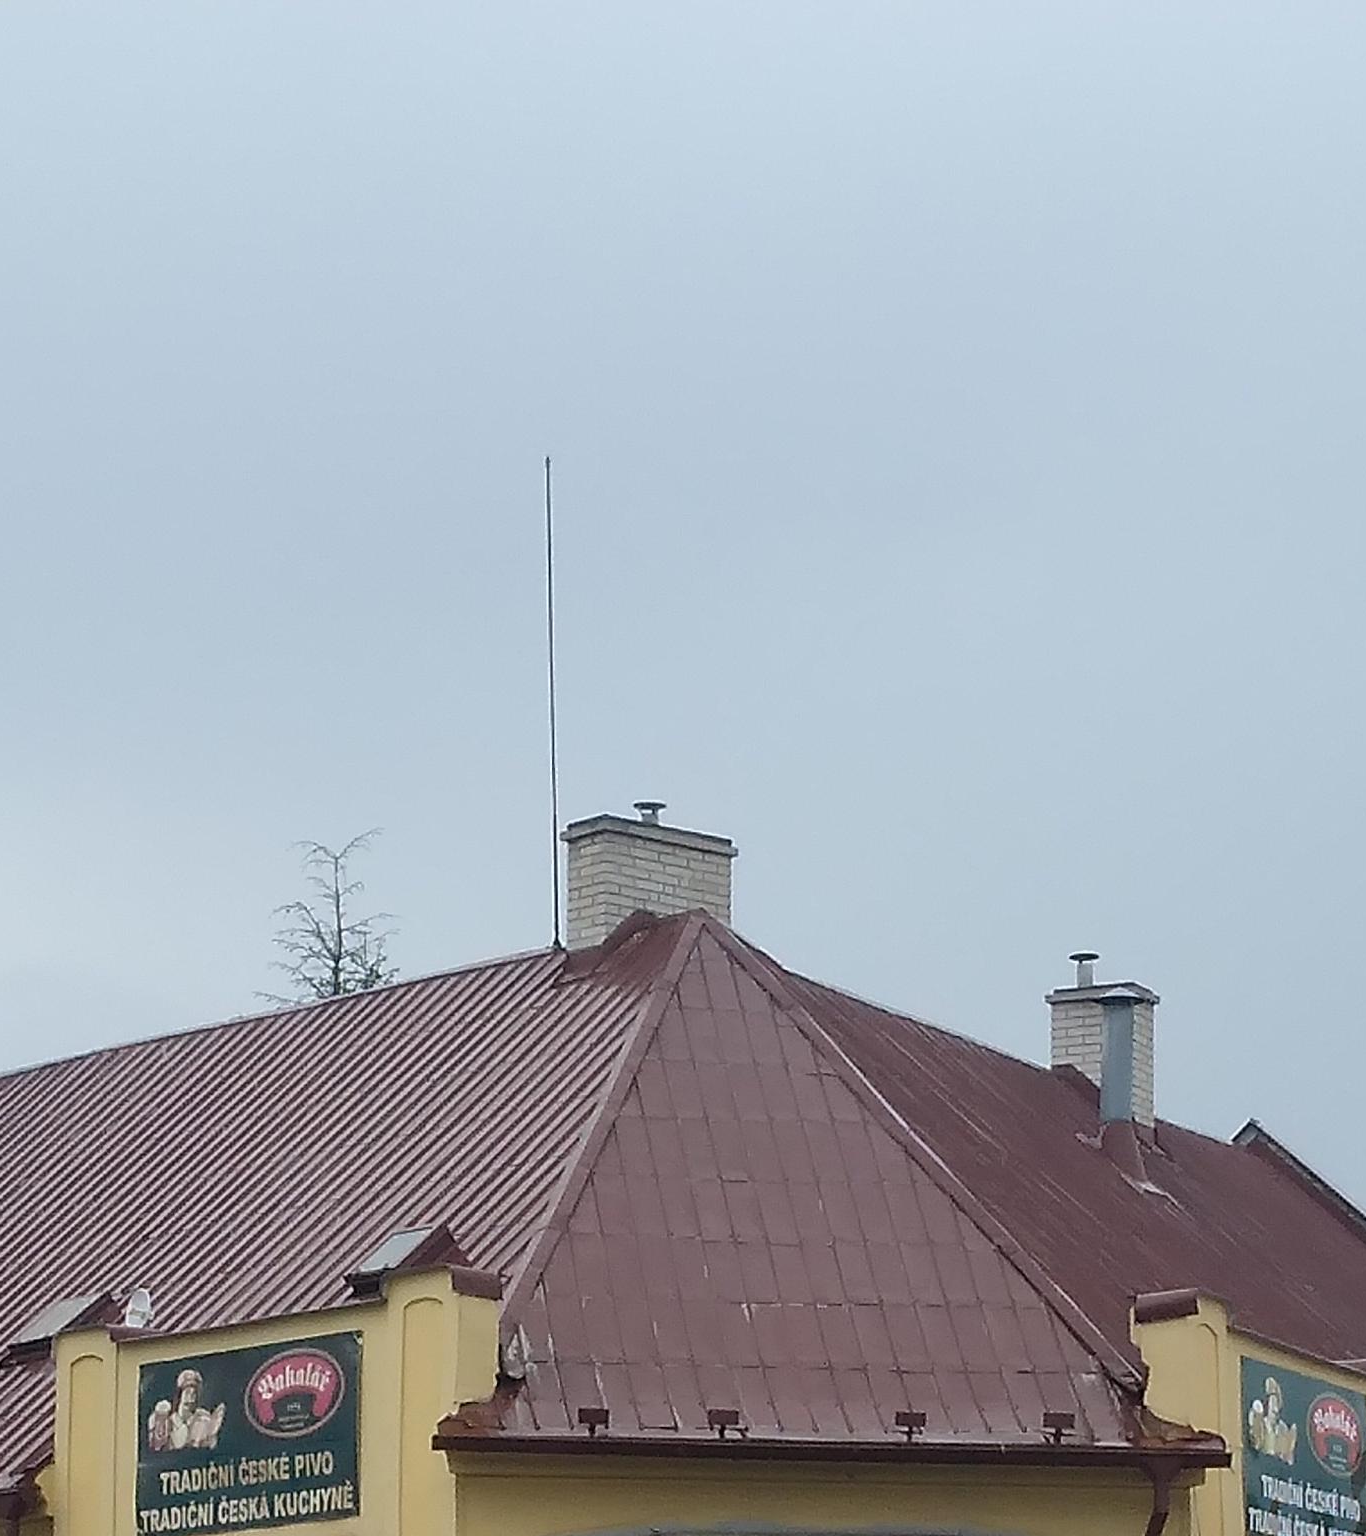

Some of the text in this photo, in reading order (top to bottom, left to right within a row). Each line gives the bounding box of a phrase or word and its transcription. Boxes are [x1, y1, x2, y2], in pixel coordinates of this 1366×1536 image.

[258, 1362, 332, 1399] Bakalář
[160, 1450, 334, 1496] TRADIČNÍ ČESKÉ PIVO
[139, 1480, 355, 1533] TRADIČNÍ ČESKÁ KUCHYNĚ
